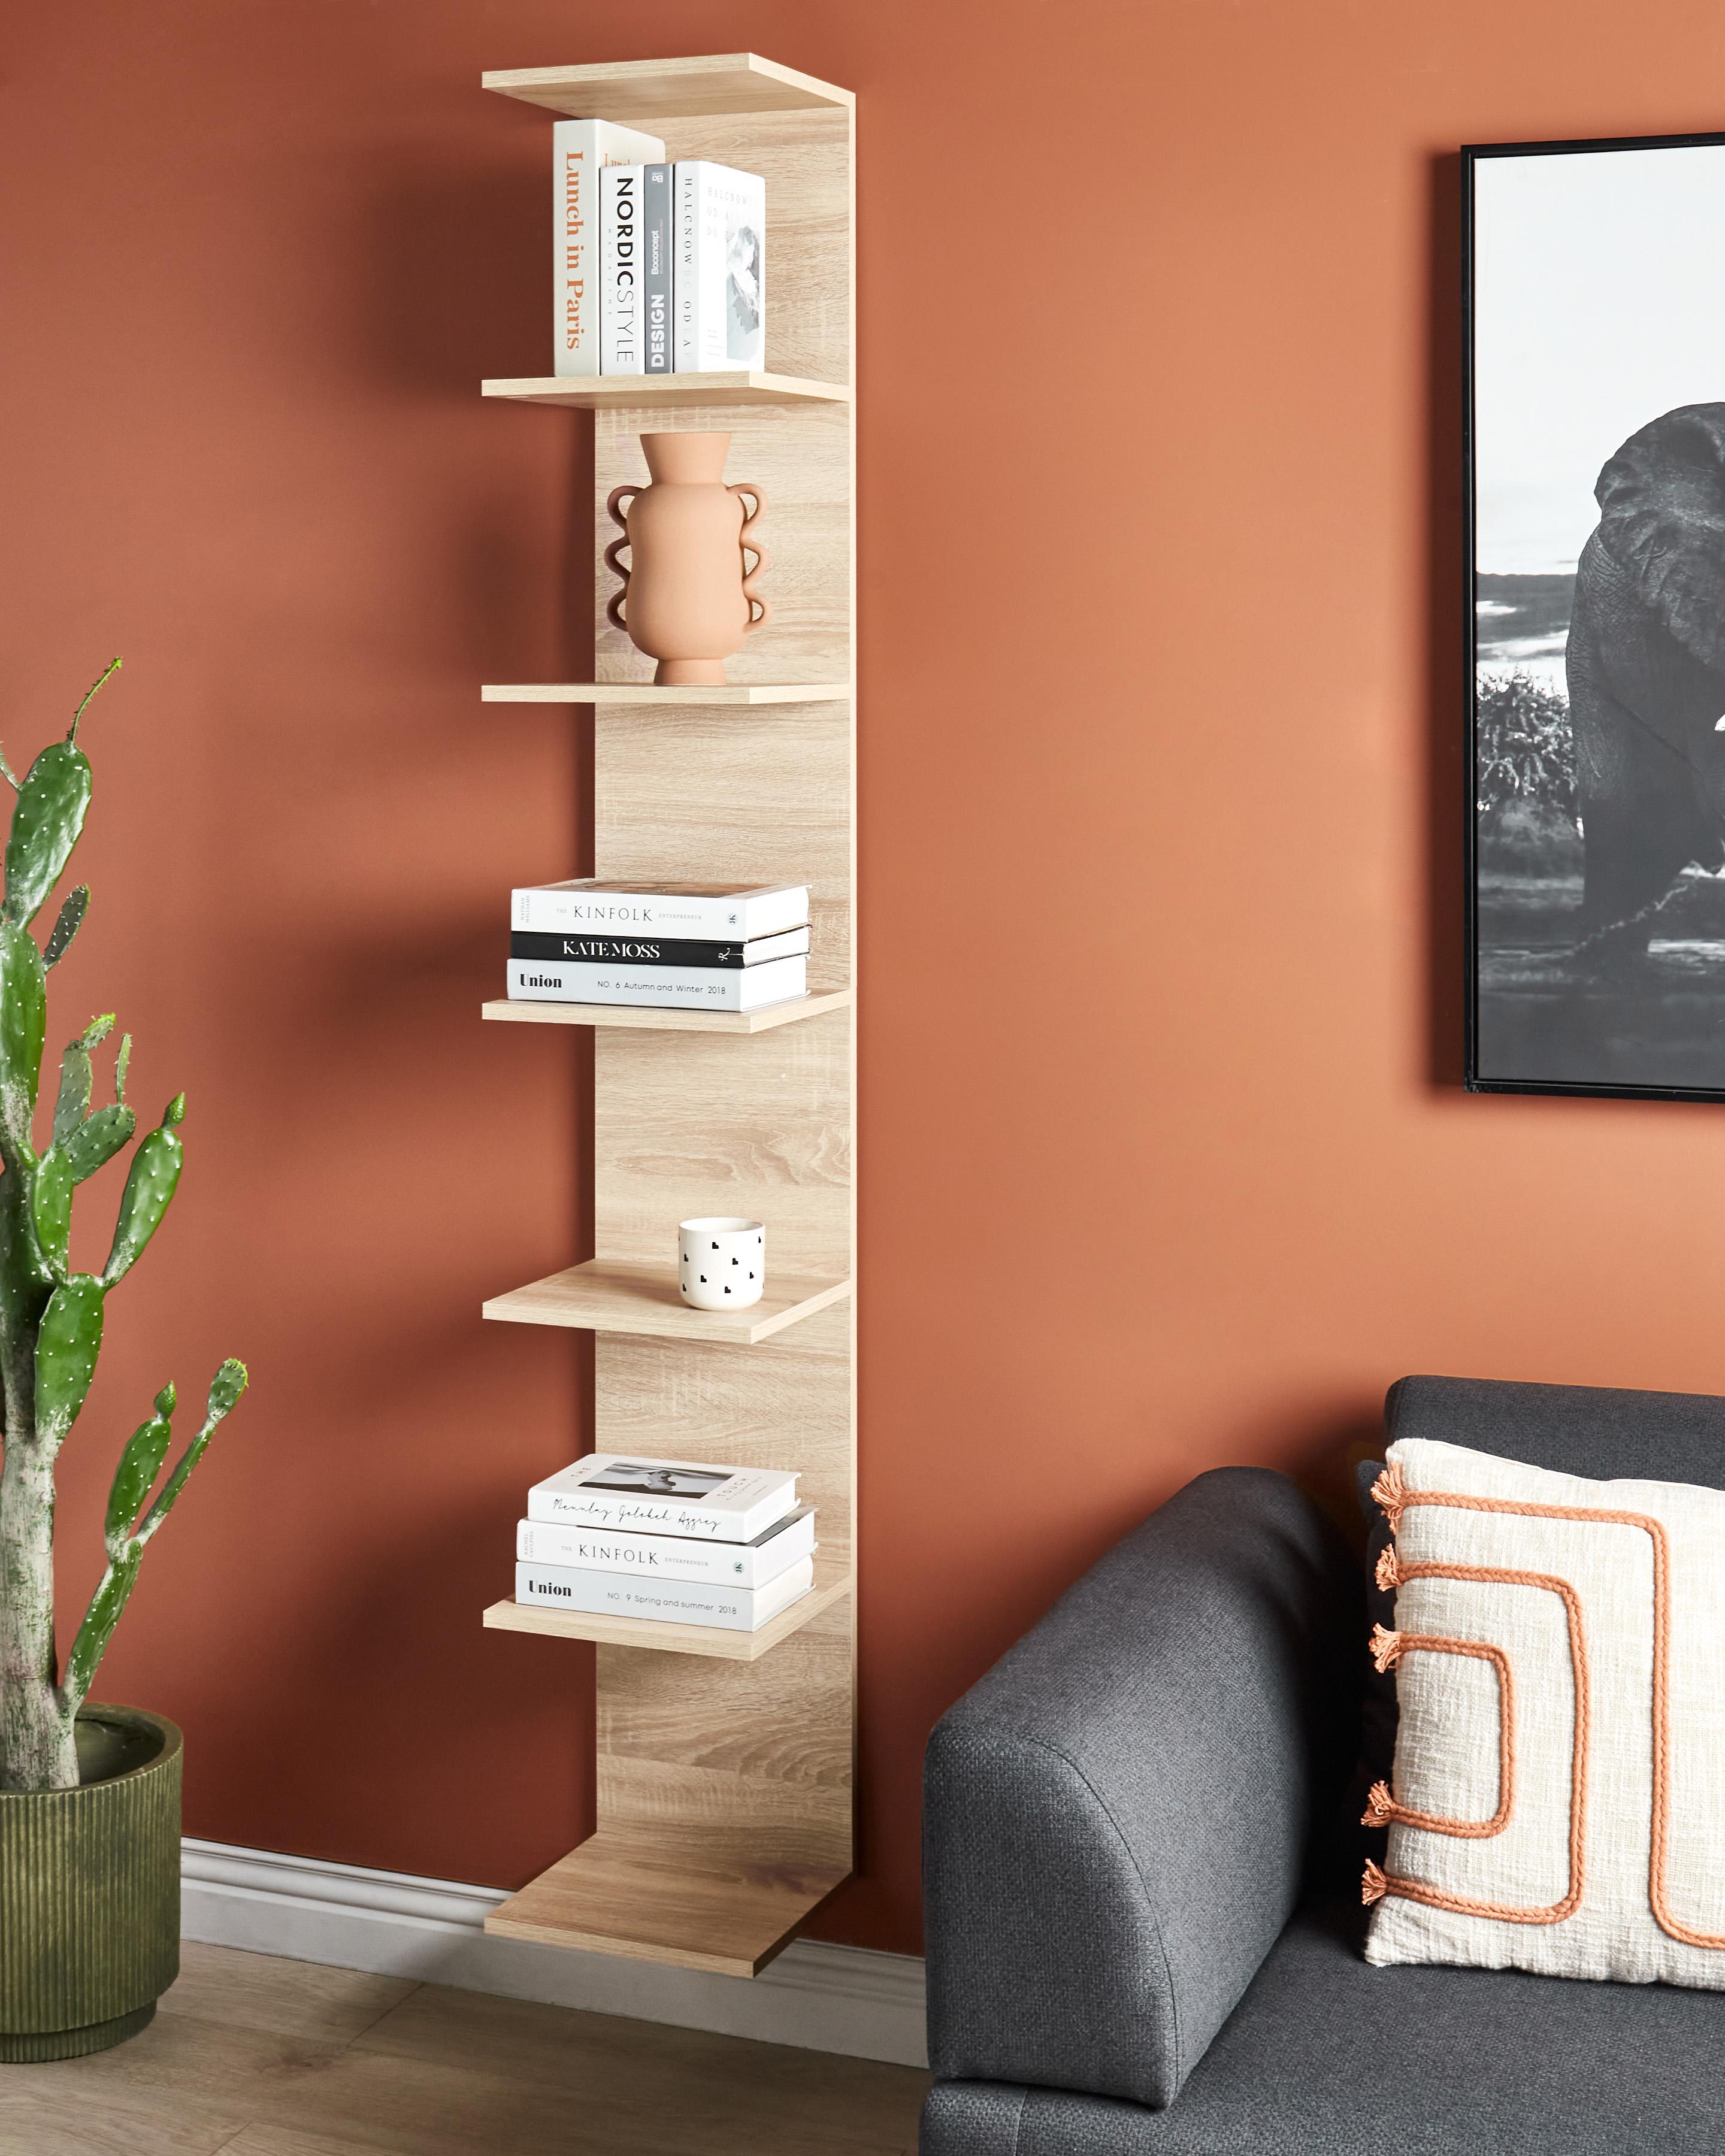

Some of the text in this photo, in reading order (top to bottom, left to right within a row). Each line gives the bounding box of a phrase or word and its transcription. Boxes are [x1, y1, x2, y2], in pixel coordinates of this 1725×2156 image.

[565, 150, 585, 350] Lunch in Paris
[651, 229, 665, 368] DESIGN Boconcept
[574, 906, 653, 922] KINFOLK
[520, 973, 727, 995] Union NO. 6 Autumn and Winter 2018
[579, 1545, 659, 1565] KINFOLK
[529, 1579, 572, 1597] Union
[607, 1592, 622, 1601] NO.
[634, 1595, 662, 1606] Spring
[663, 1598, 679, 1607] and
[680, 1601, 714, 1612] summer
[719, 1605, 737, 1615] 2018
